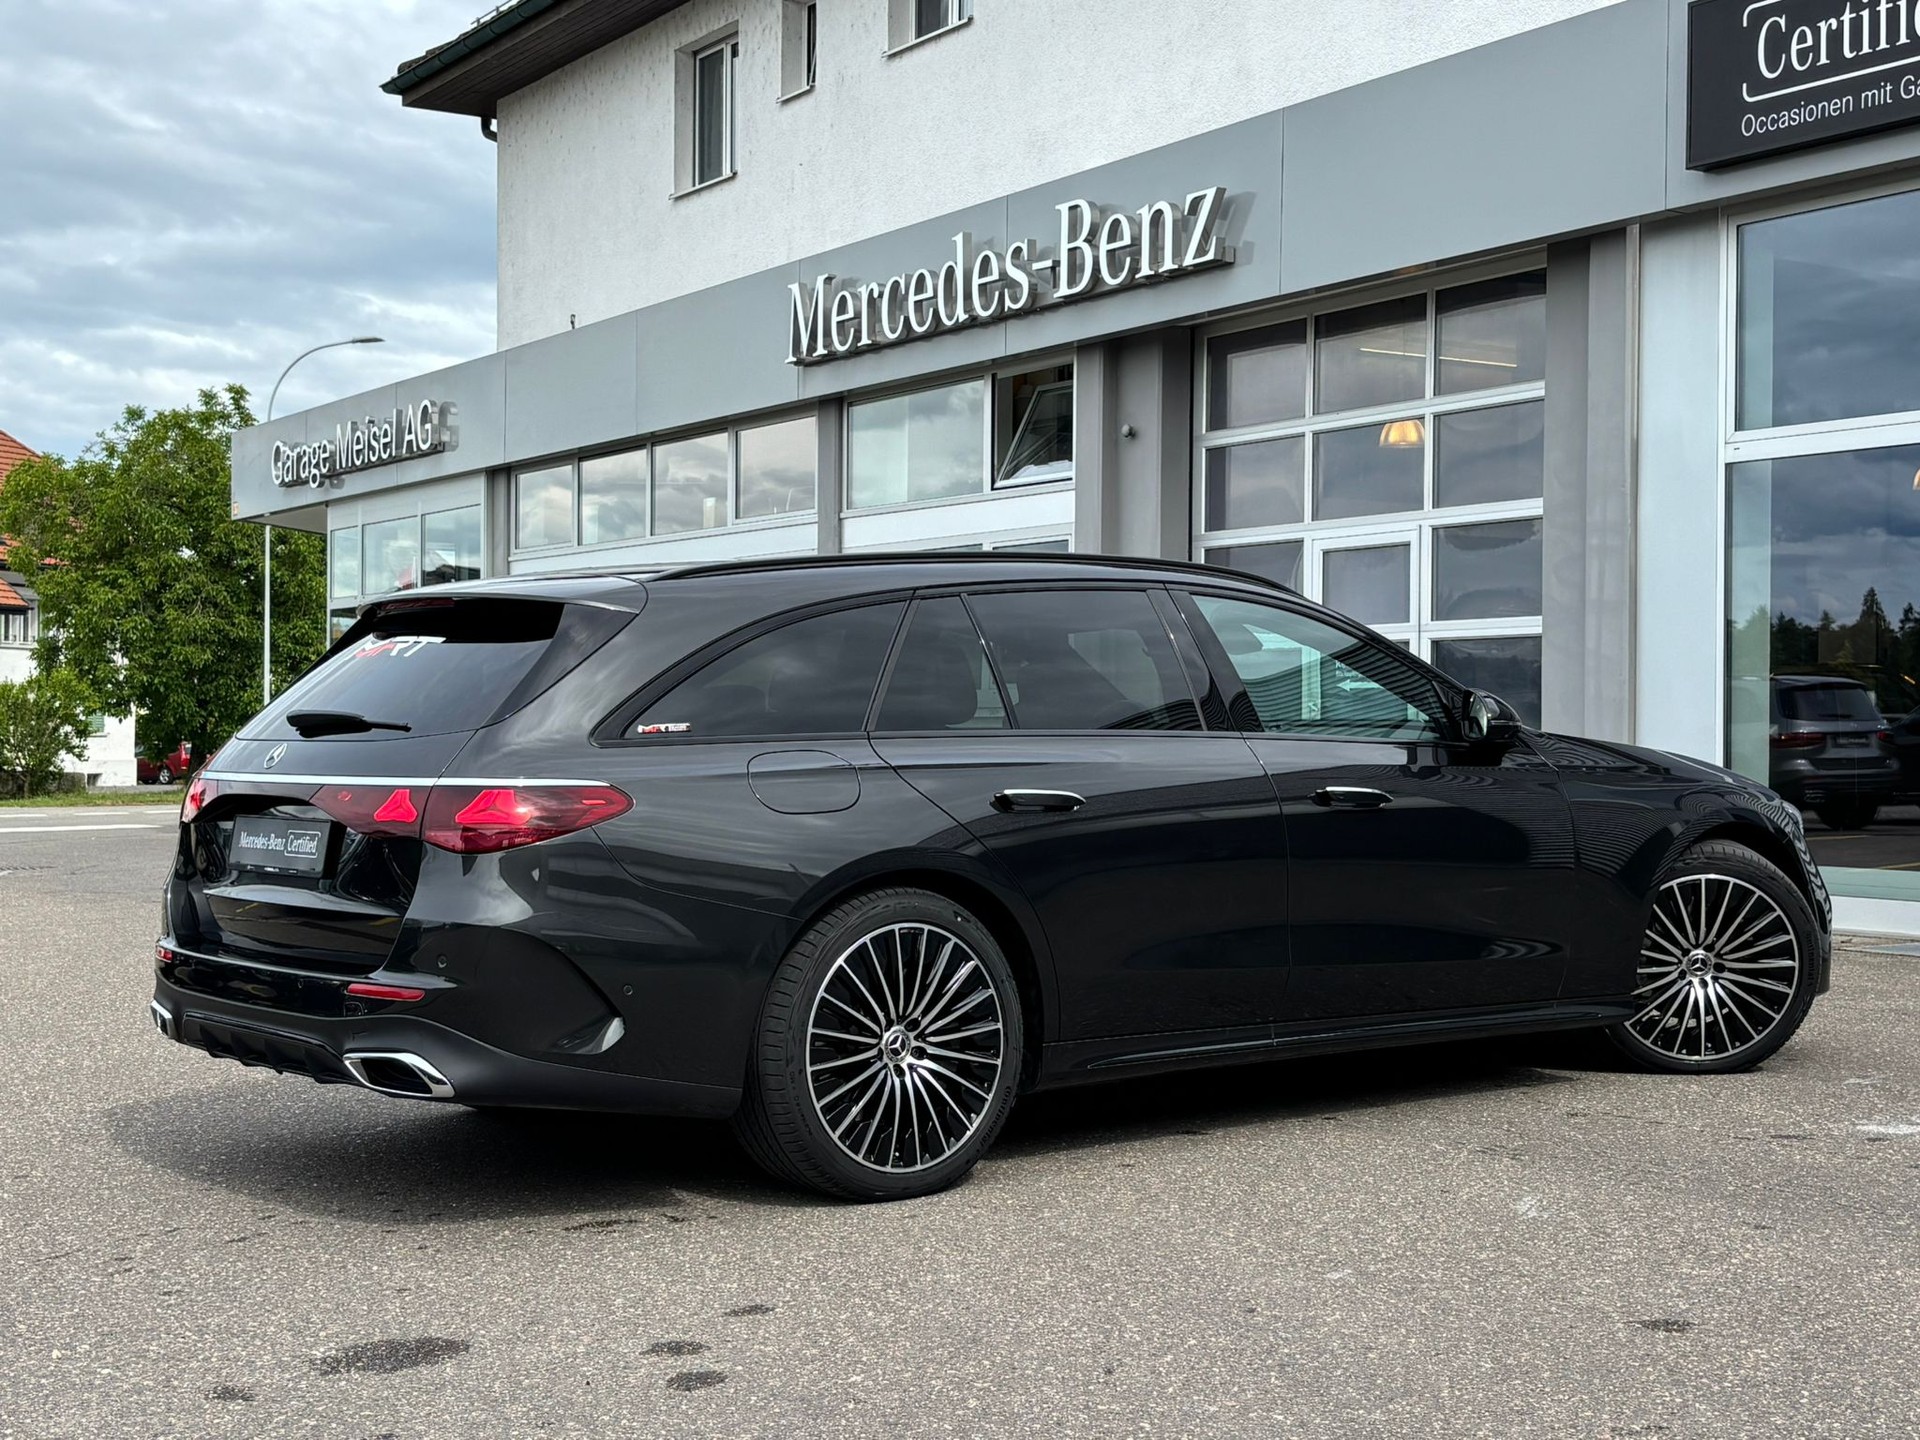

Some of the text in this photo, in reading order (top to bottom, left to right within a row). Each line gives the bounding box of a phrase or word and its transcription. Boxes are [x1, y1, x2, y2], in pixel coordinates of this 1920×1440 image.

[1757, 0, 1920, 79] Certifi
[1741, 95, 1853, 137] Occasionen
[1861, 81, 1893, 109] mit
[785, 186, 1227, 365] Mercedes-Benz
[271, 399, 432, 488] Garage Meisel AG
[239, 831, 319, 853] Mercedes-Benz Certified
